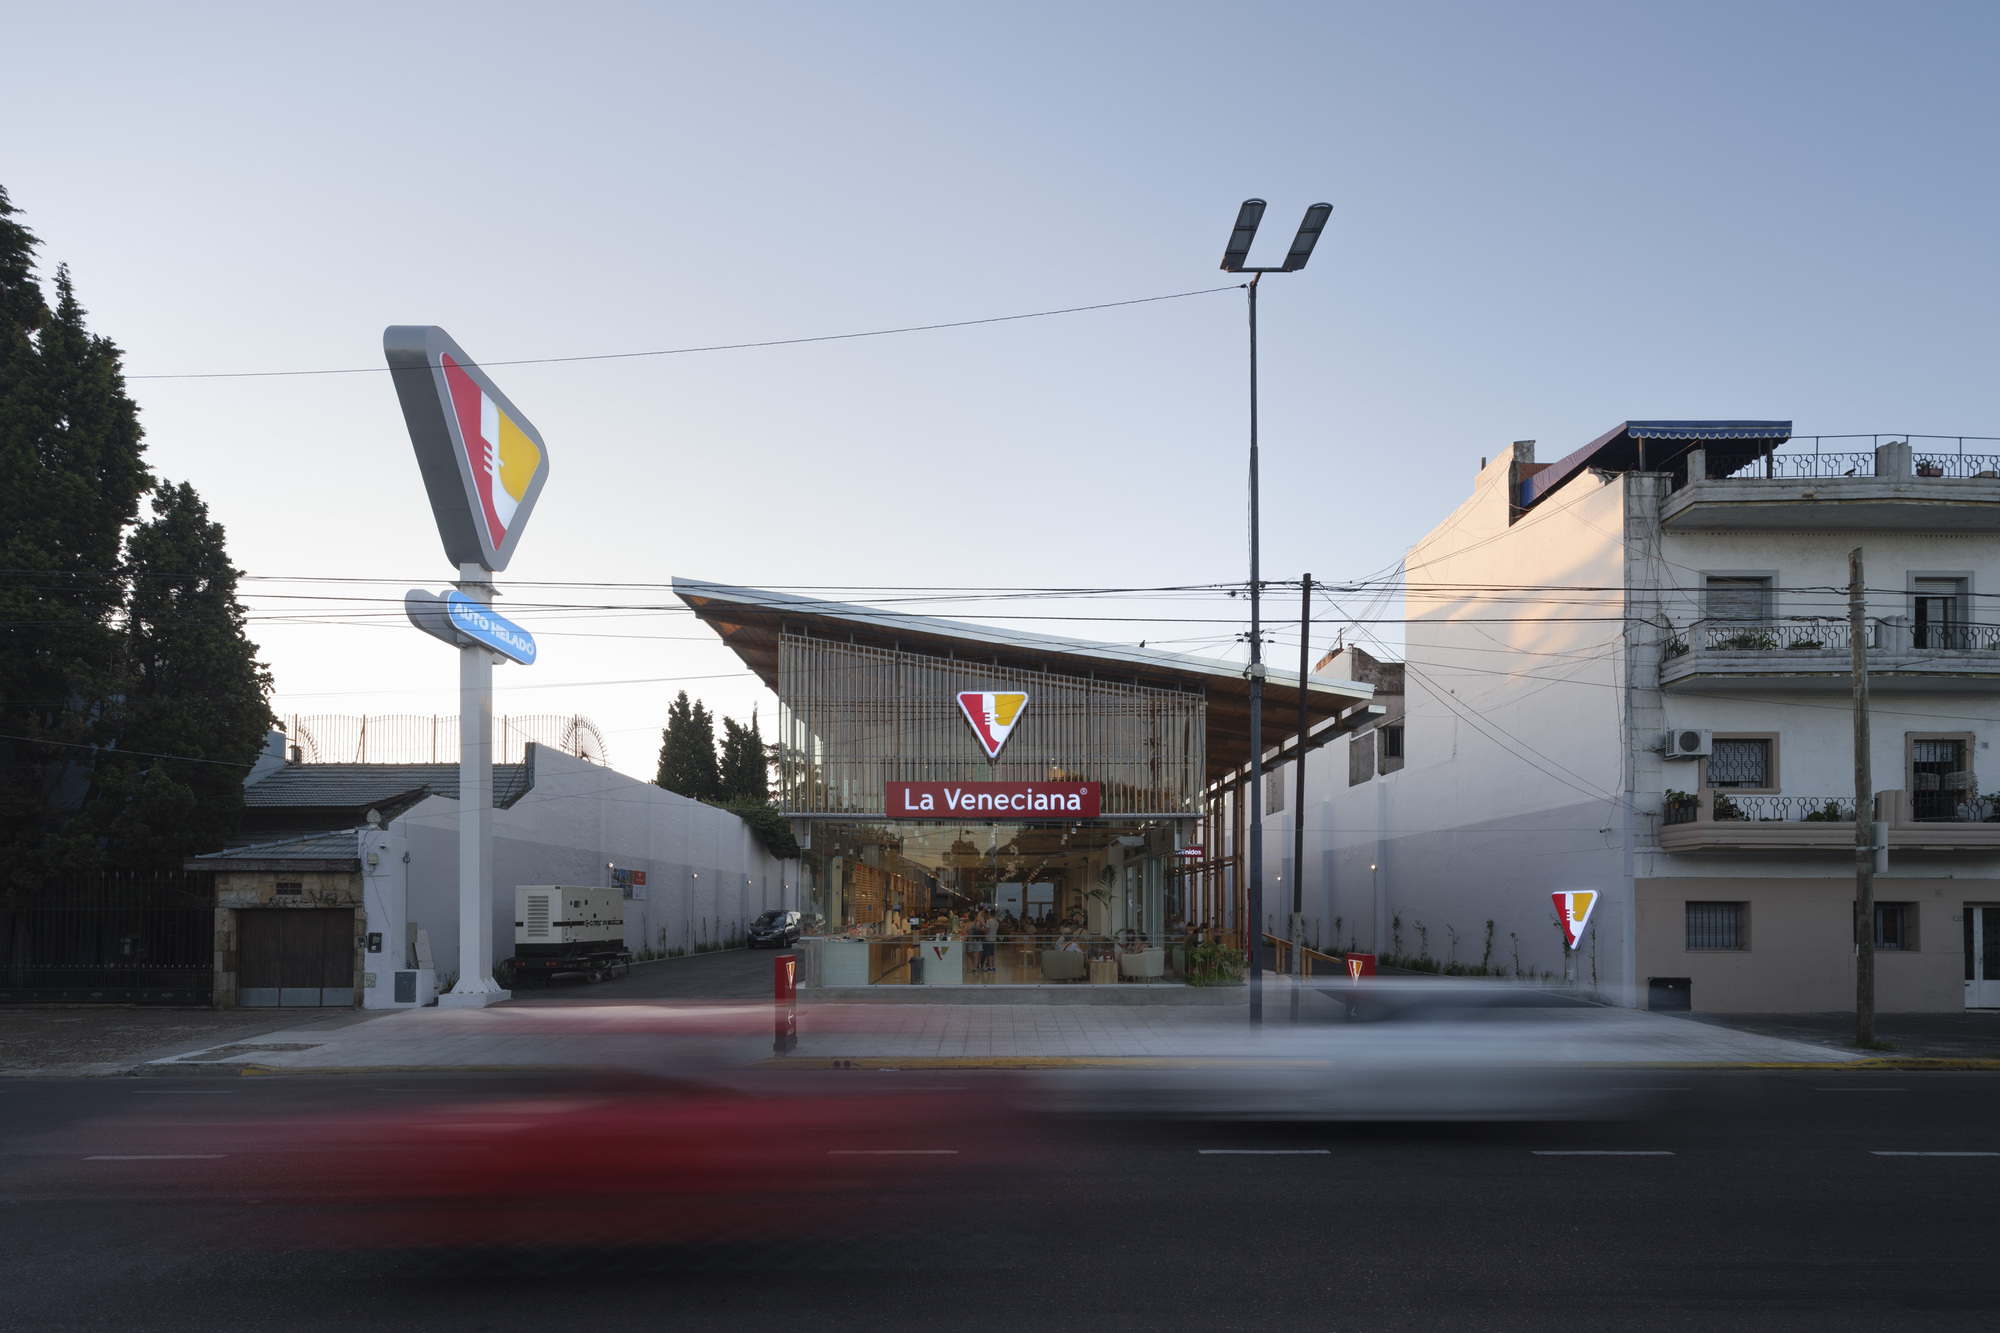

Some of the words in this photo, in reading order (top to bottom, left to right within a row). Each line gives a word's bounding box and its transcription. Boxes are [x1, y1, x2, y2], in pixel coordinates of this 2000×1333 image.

[453, 603, 489, 630] AUTO
[490, 620, 535, 656] HELADO
[904, 787, 935, 811] La
